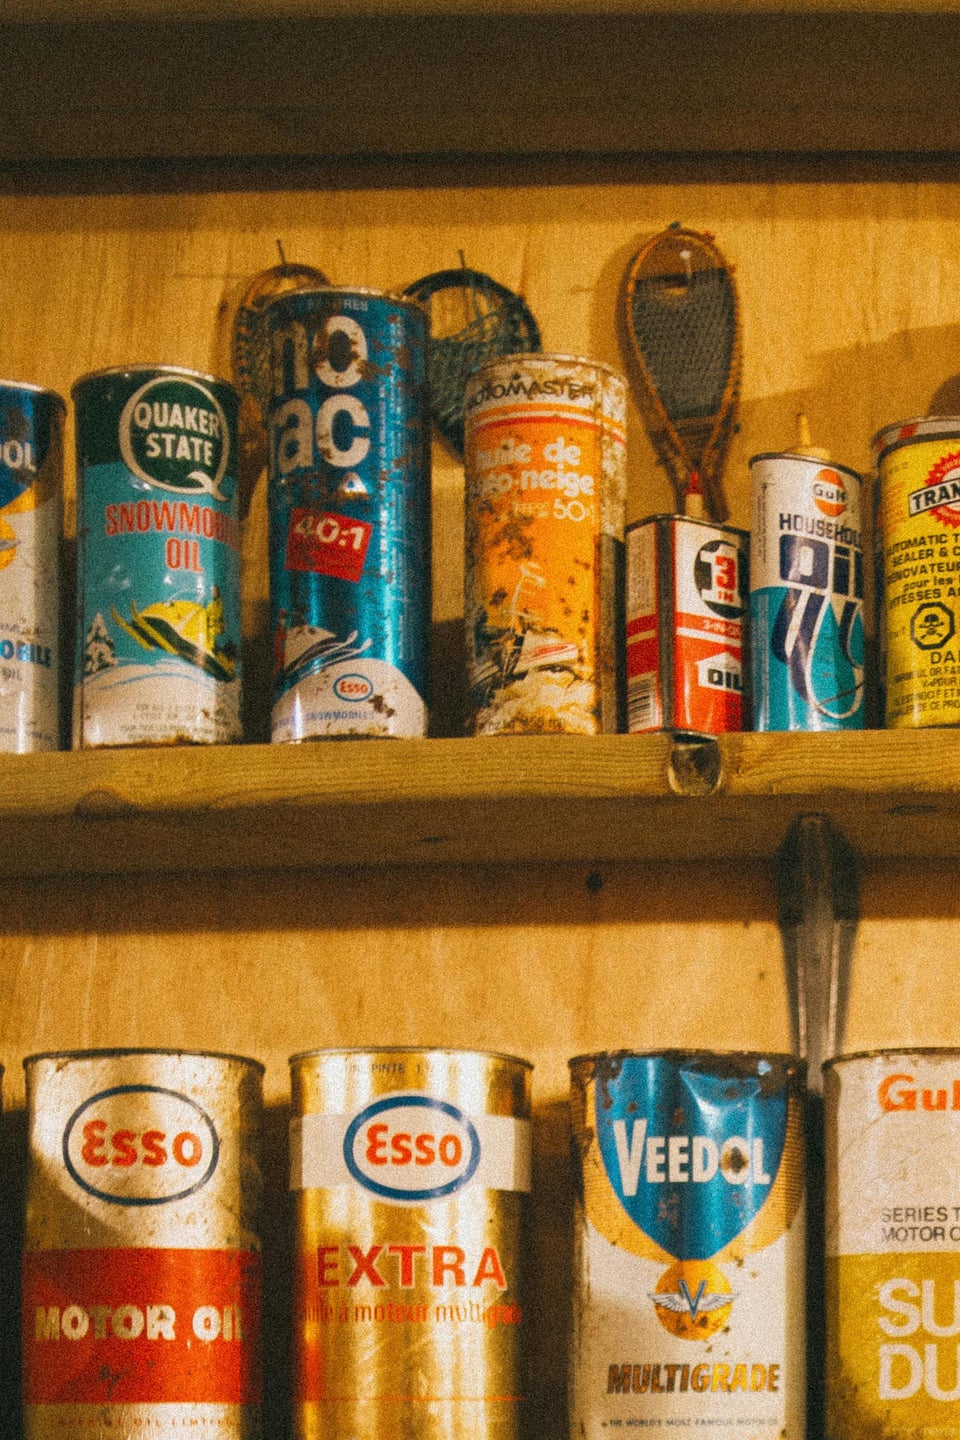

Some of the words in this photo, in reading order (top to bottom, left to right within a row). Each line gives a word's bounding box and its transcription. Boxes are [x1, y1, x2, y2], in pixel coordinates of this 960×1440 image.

[133, 400, 220, 437] QUAKER
[146, 433, 216, 466] STATE
[165, 538, 204, 573] OIL
[714, 555, 738, 591] 3
[892, 549, 935, 568] SEALER
[938, 546, 949, 557] &
[934, 575, 954, 587] les
[338, 681, 370, 696] Esso
[81, 1118, 203, 1169] Esso
[365, 1122, 463, 1168] Esso
[612, 1118, 772, 1198] VEEDOL
[880, 1206, 949, 1224] SERIES
[880, 1225, 946, 1243] MOTOR
[316, 1244, 508, 1290] EXTRA
[34, 1303, 177, 1342] MOTOR
[606, 1362, 781, 1395] MULTIGRADE
